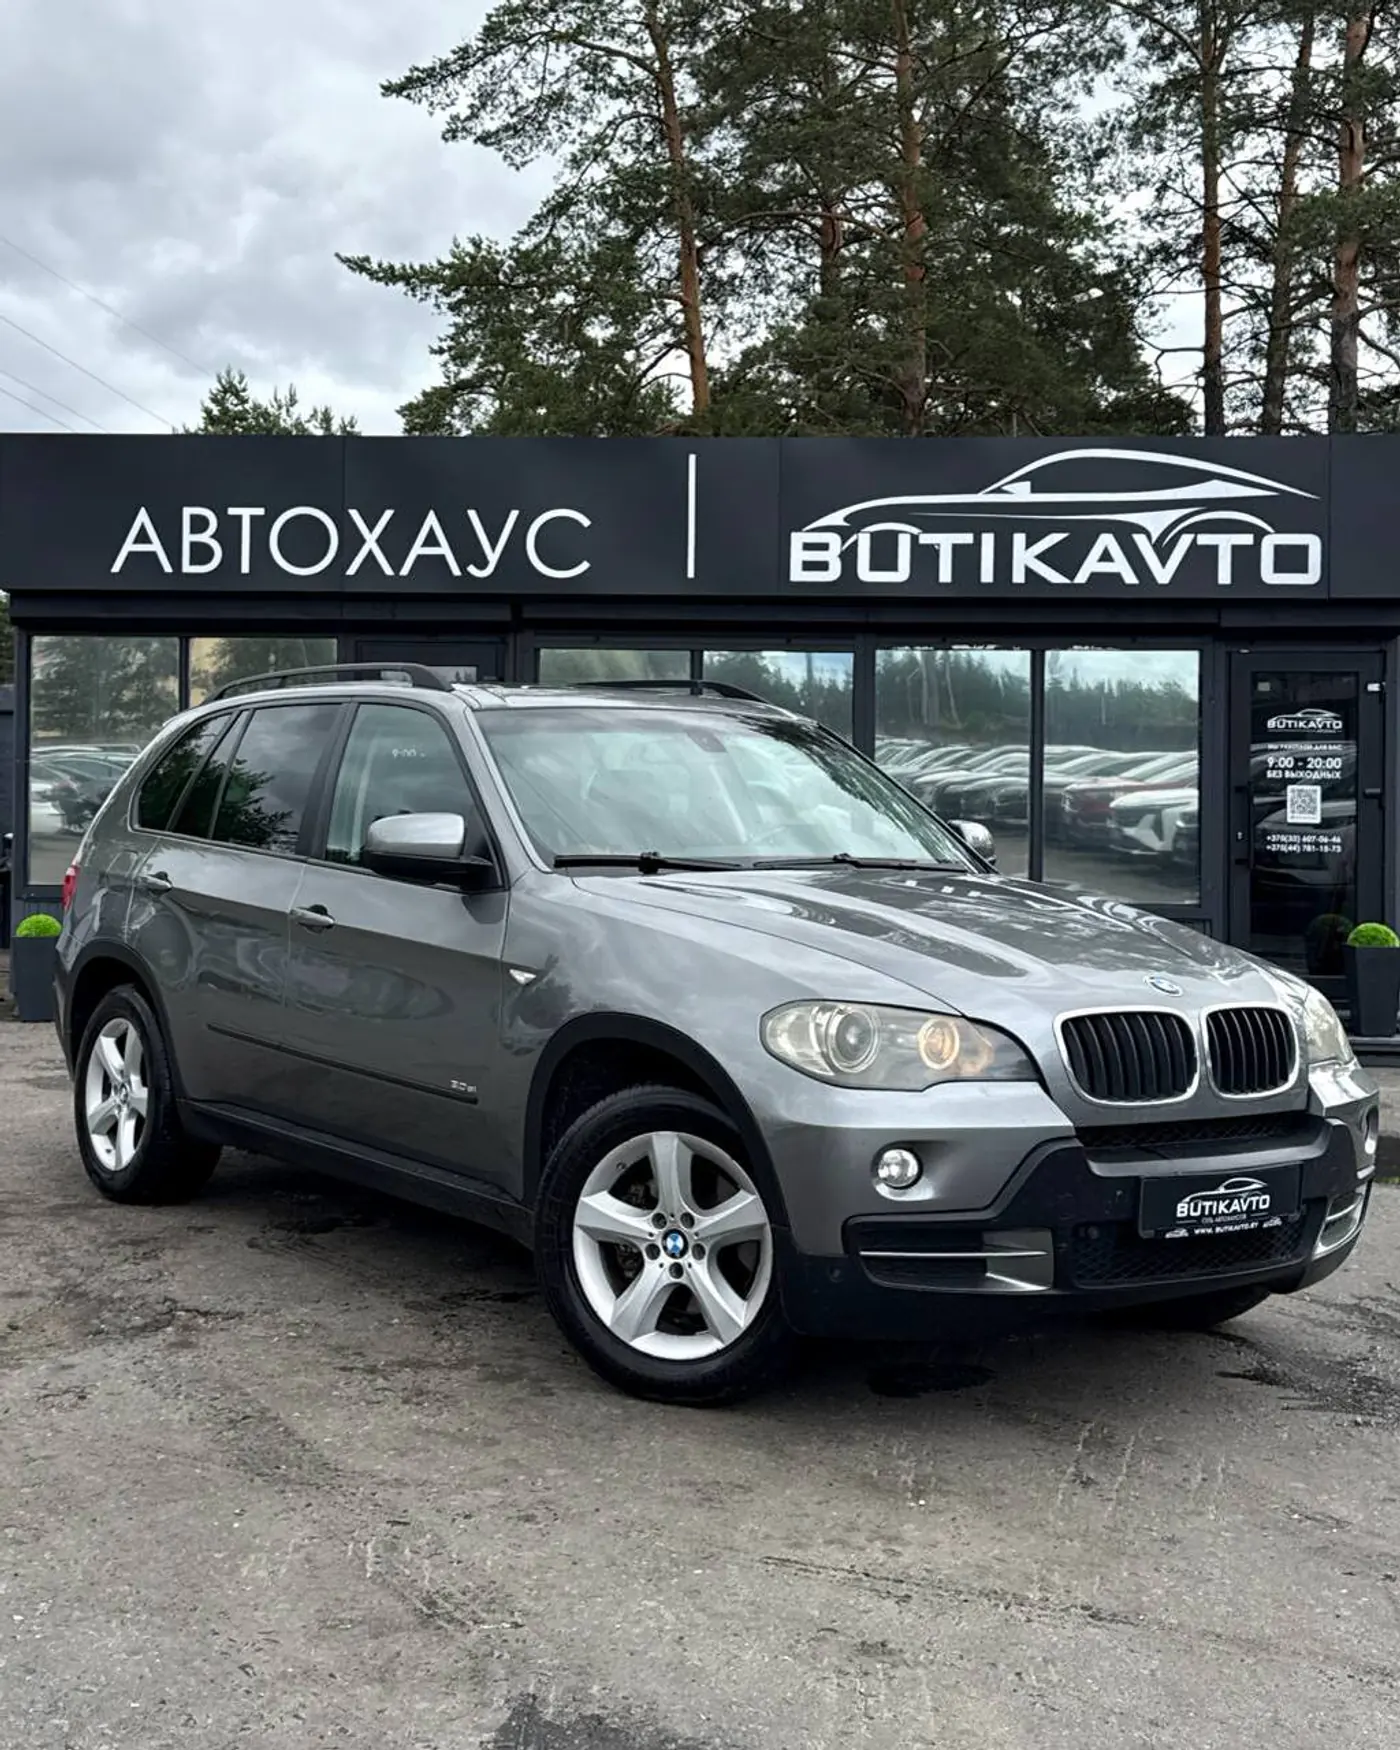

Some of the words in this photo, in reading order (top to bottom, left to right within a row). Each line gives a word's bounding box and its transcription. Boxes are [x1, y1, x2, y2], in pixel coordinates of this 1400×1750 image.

[110, 506, 592, 578] АВТОХАУС
[789, 531, 1323, 585] BUTIKAVTO
[1267, 720, 1343, 729] BUTIKAVTO
[1267, 756, 1294, 769] 9:00
[1306, 757, 1342, 769] 20:00
[1266, 770, 1283, 778] БЕЗ
[1284, 770, 1342, 779] ВЫХОДНЫХ
[1176, 1195, 1270, 1217] BUTIKAVTO
